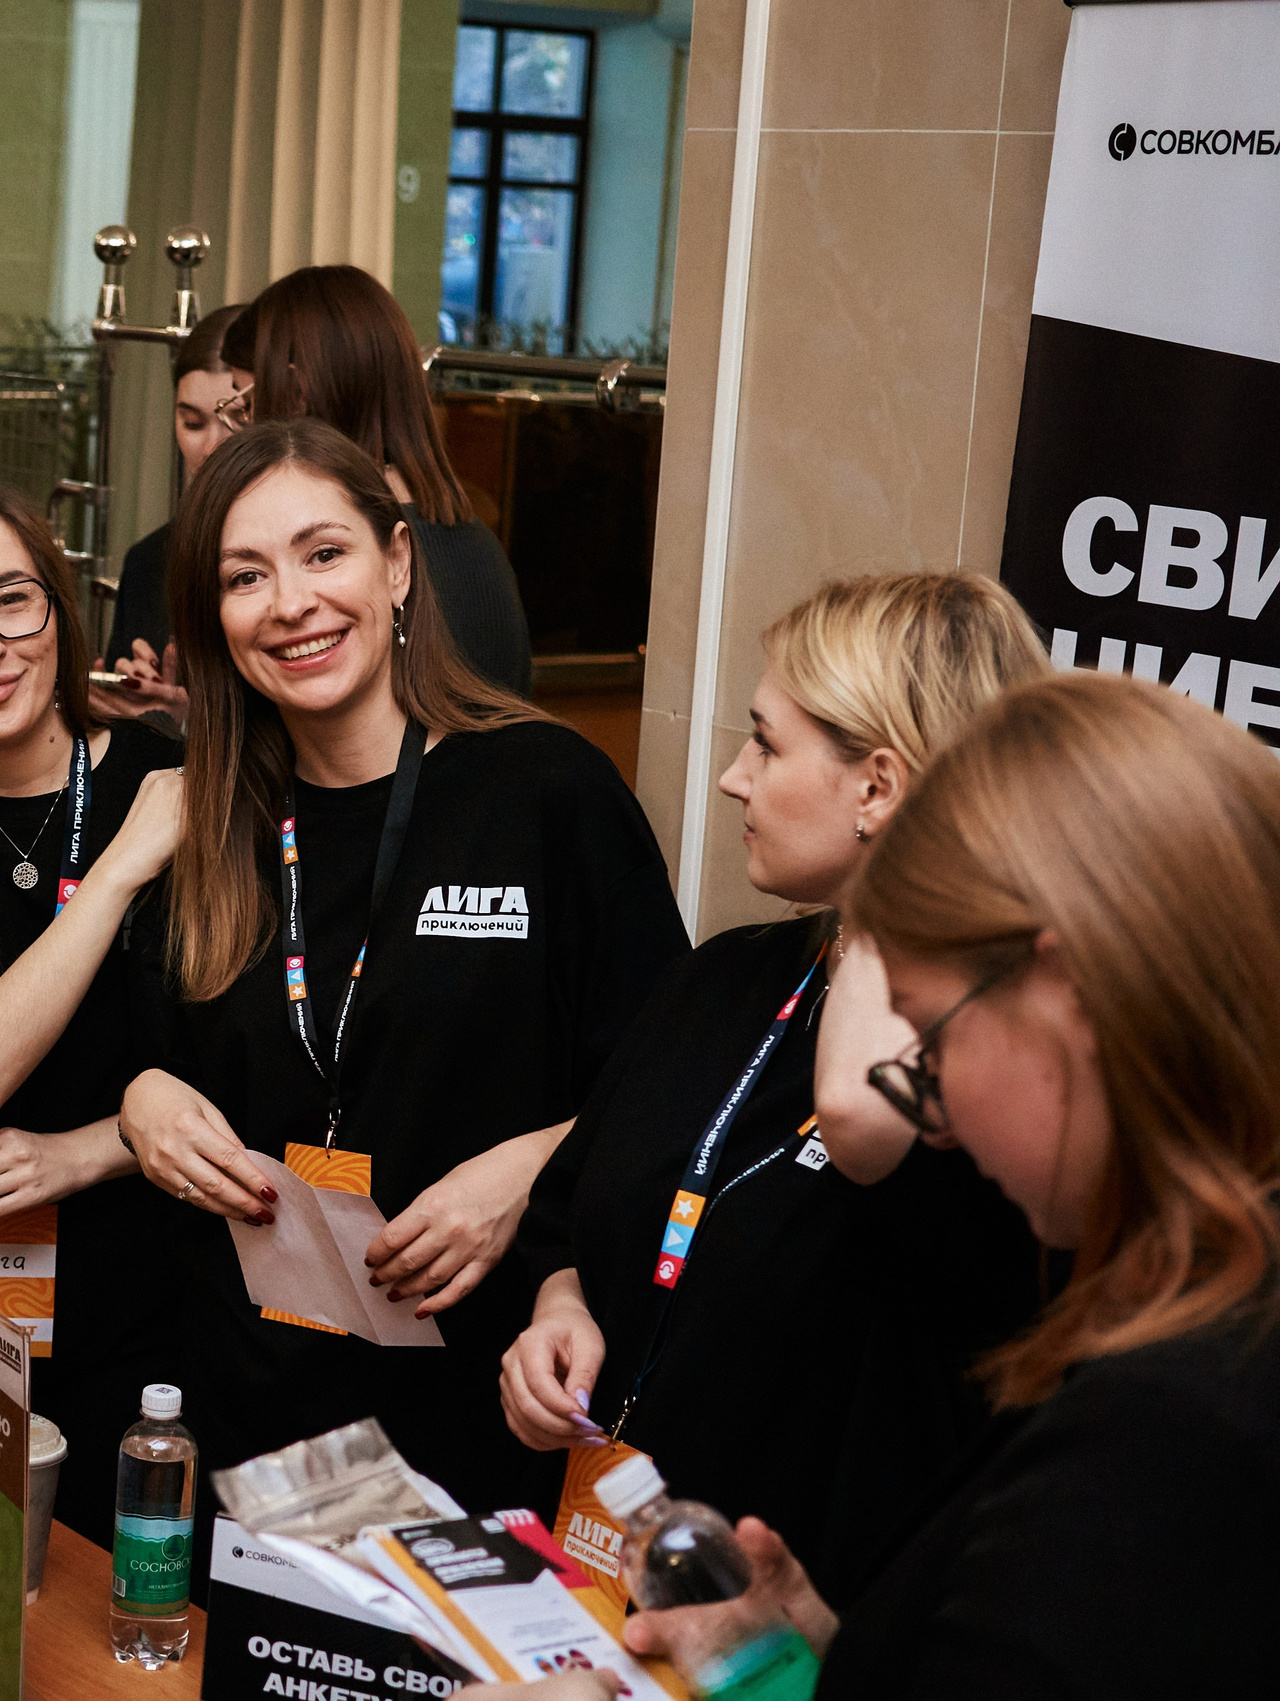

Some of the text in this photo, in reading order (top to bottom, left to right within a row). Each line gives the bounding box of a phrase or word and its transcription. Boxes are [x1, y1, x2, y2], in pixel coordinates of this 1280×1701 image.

[70, 832, 80, 864] ЛИГА
[420, 886, 529, 913] ЛИГА
[421, 919, 523, 931] приключений
[694, 1035, 775, 1175] ЛИГА ПРИКЛЮЧЕНИЙ
[567, 1511, 623, 1557] ЛИГА
[566, 1540, 618, 1572] приключений
[248, 1635, 462, 1698] ОСТАВЬ СВО
